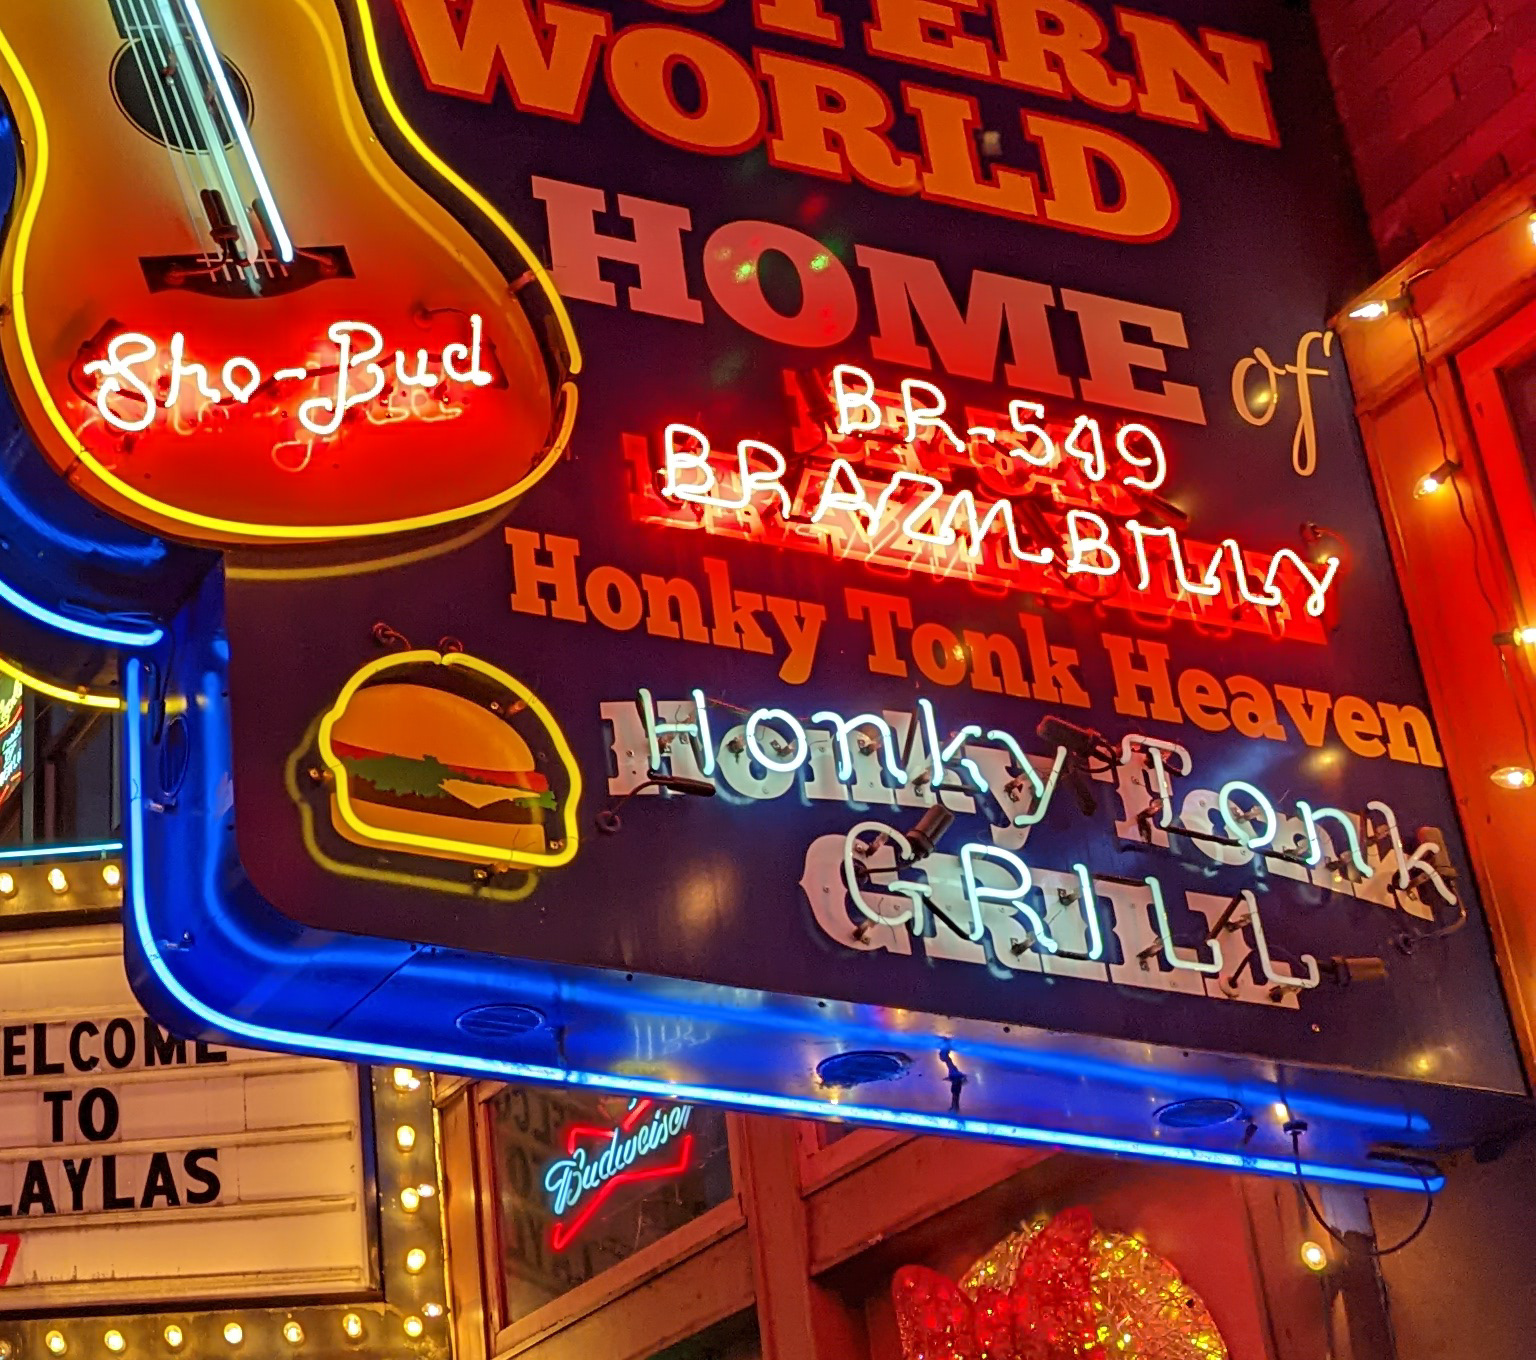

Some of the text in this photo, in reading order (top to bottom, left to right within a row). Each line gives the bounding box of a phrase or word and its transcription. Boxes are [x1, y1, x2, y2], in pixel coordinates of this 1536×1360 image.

[82, 313, 493, 436] Sho-Bud
[530, 174, 1333, 477] HOME of
[830, 362, 1168, 492] BR-549
[504, 528, 1445, 769] Honky Tonk Heaven
[600, 688, 1459, 921] Honky Tonk
[798, 821, 1321, 1010] GRILL
[43, 1087, 120, 1143] TO
[544, 1105, 694, 1215] Budweiser
